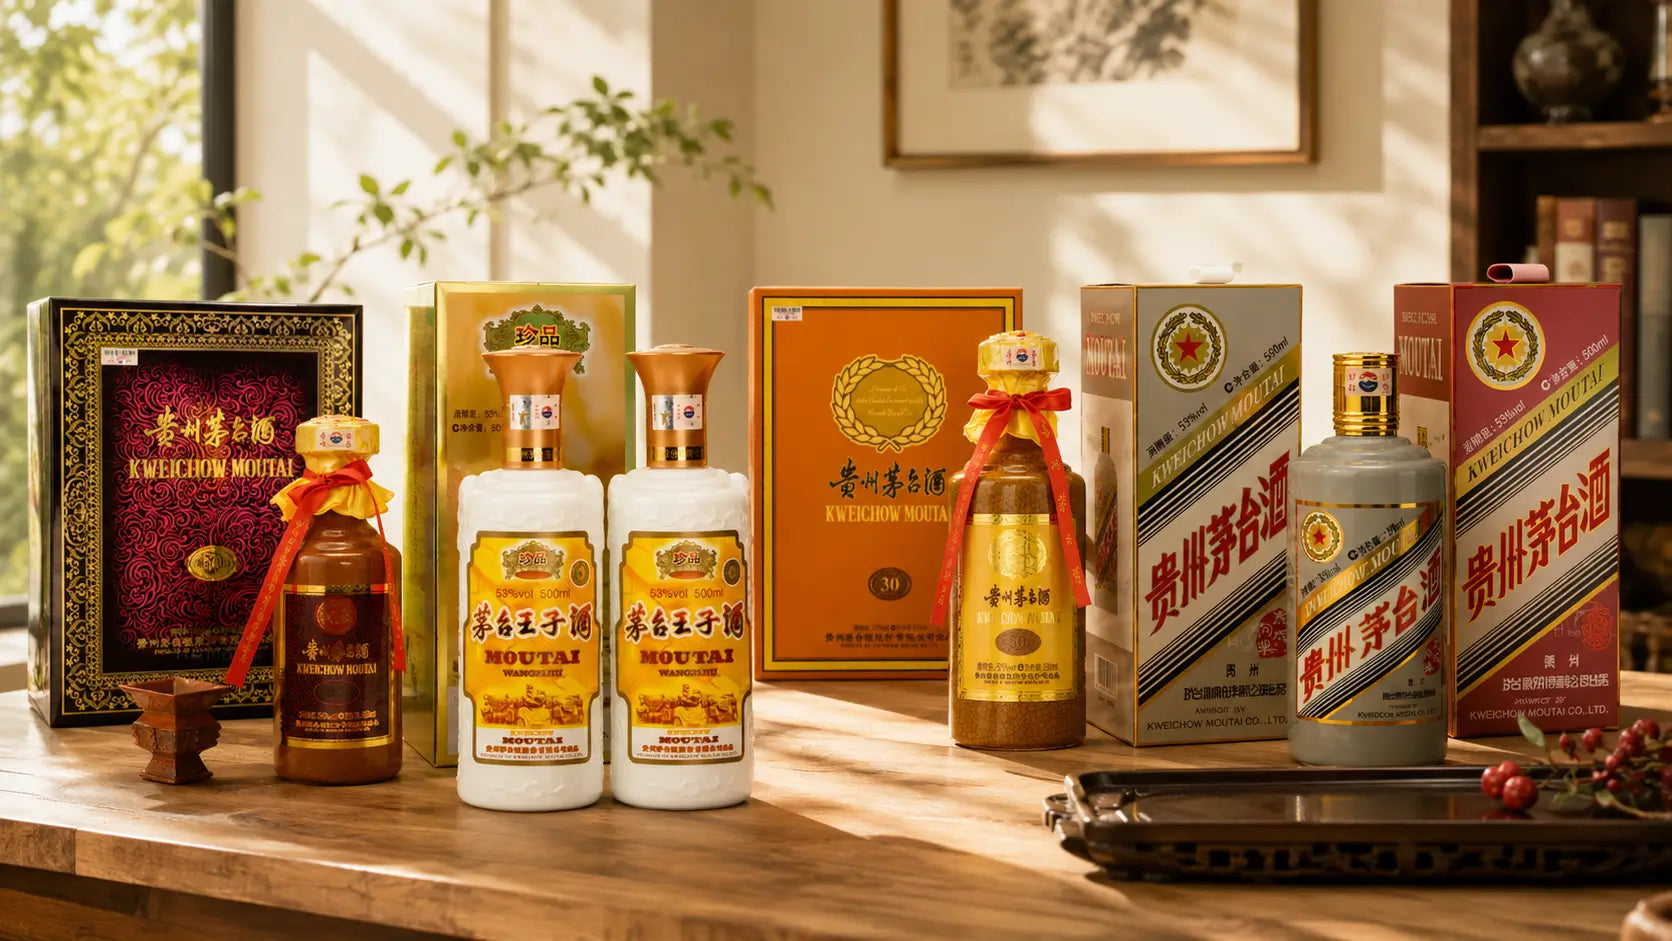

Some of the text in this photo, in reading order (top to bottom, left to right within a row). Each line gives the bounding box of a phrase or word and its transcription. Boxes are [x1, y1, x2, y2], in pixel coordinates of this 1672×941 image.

[514, 324, 562, 347] 珍品
[1398, 335, 1444, 381] MOUTAI
[1151, 413, 1229, 489] KWEICHOW
[1230, 366, 1285, 425] MOUTAI
[1468, 408, 1545, 483] KWEICHOW
[1548, 363, 1605, 422] MOUTAI
[129, 457, 295, 479] KWEICHOW MOUTAI
[824, 504, 949, 523] KWEICHOW MOUTA
[1145, 449, 1290, 638] 贵州茅台酒
[1462, 447, 1611, 624] 贵州茅台酒
[518, 551, 547, 565] 珍品
[673, 551, 701, 565] 珍品
[495, 587, 572, 599] 53%vol 500ml
[649, 587, 725, 599] 53%vol 500ml
[880, 577, 900, 592] 30
[470, 600, 593, 643] 茅台王子酒
[625, 600, 746, 643] 茅台王子酒
[1299, 545, 1442, 705] 贵州茅台酒
[485, 650, 580, 665] MOUTAI
[640, 649, 734, 664] MOUTAI
[1470, 708, 1526, 720] KWEICHOW
[1528, 707, 1565, 718] MOUTAI
[1147, 719, 1204, 731] KWEICHOW
[1206, 717, 1243, 728] MOUTAI
[502, 737, 563, 745] MOUTAI
[658, 735, 719, 744] MOUTAI
